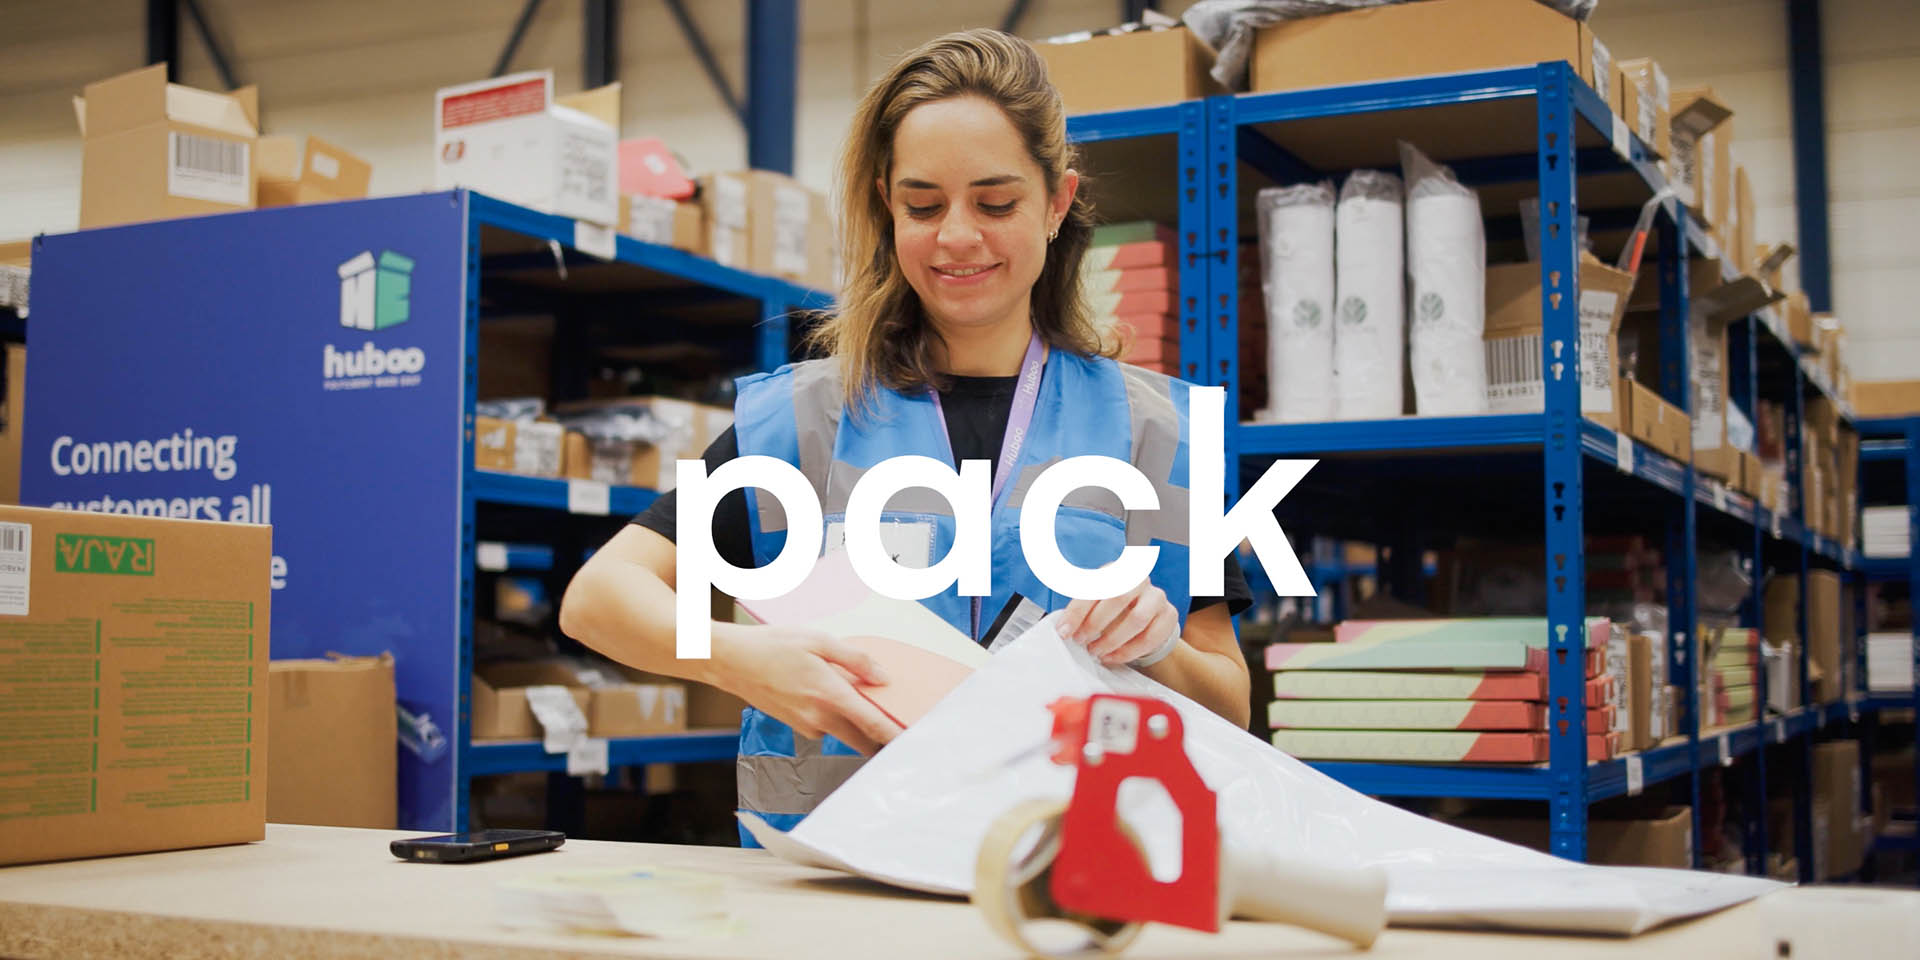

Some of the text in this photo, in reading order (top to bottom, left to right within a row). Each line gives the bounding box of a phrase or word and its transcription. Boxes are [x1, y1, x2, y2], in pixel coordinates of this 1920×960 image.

[324, 341, 425, 378] huboo
[1022, 360, 1040, 395] Huboo
[51, 427, 237, 480] Connecting
[1004, 426, 1024, 466] Huboo
[229, 483, 271, 525] all
[58, 536, 153, 573] RAJA
